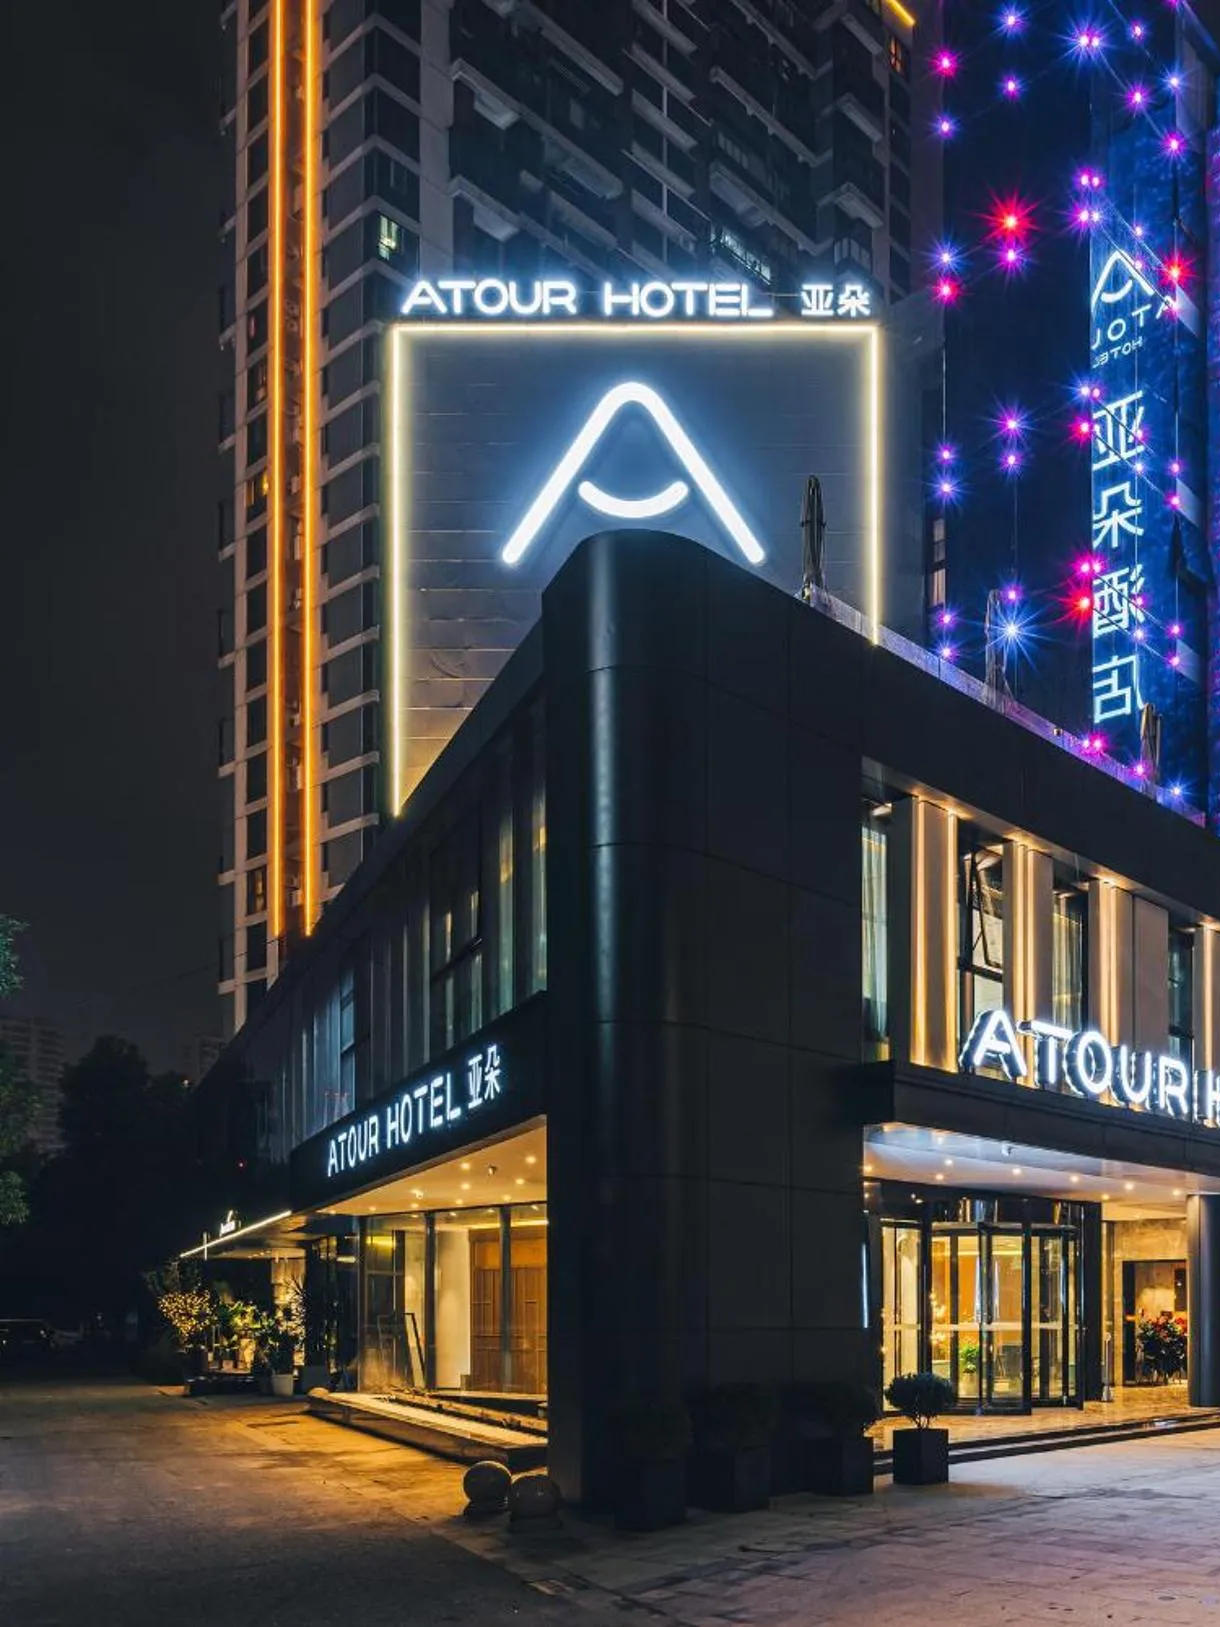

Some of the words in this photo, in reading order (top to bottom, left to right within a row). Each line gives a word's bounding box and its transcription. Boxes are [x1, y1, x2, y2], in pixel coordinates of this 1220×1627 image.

[401, 278, 578, 317] ATOUR
[604, 280, 774, 318] HOTEL
[800, 283, 872, 319] 亚朵
[327, 1114, 380, 1177] ATOUR
[387, 1072, 462, 1149] HOTEL
[467, 1044, 502, 1109] 亚朵
[964, 1008, 1189, 1118] ATOUR
